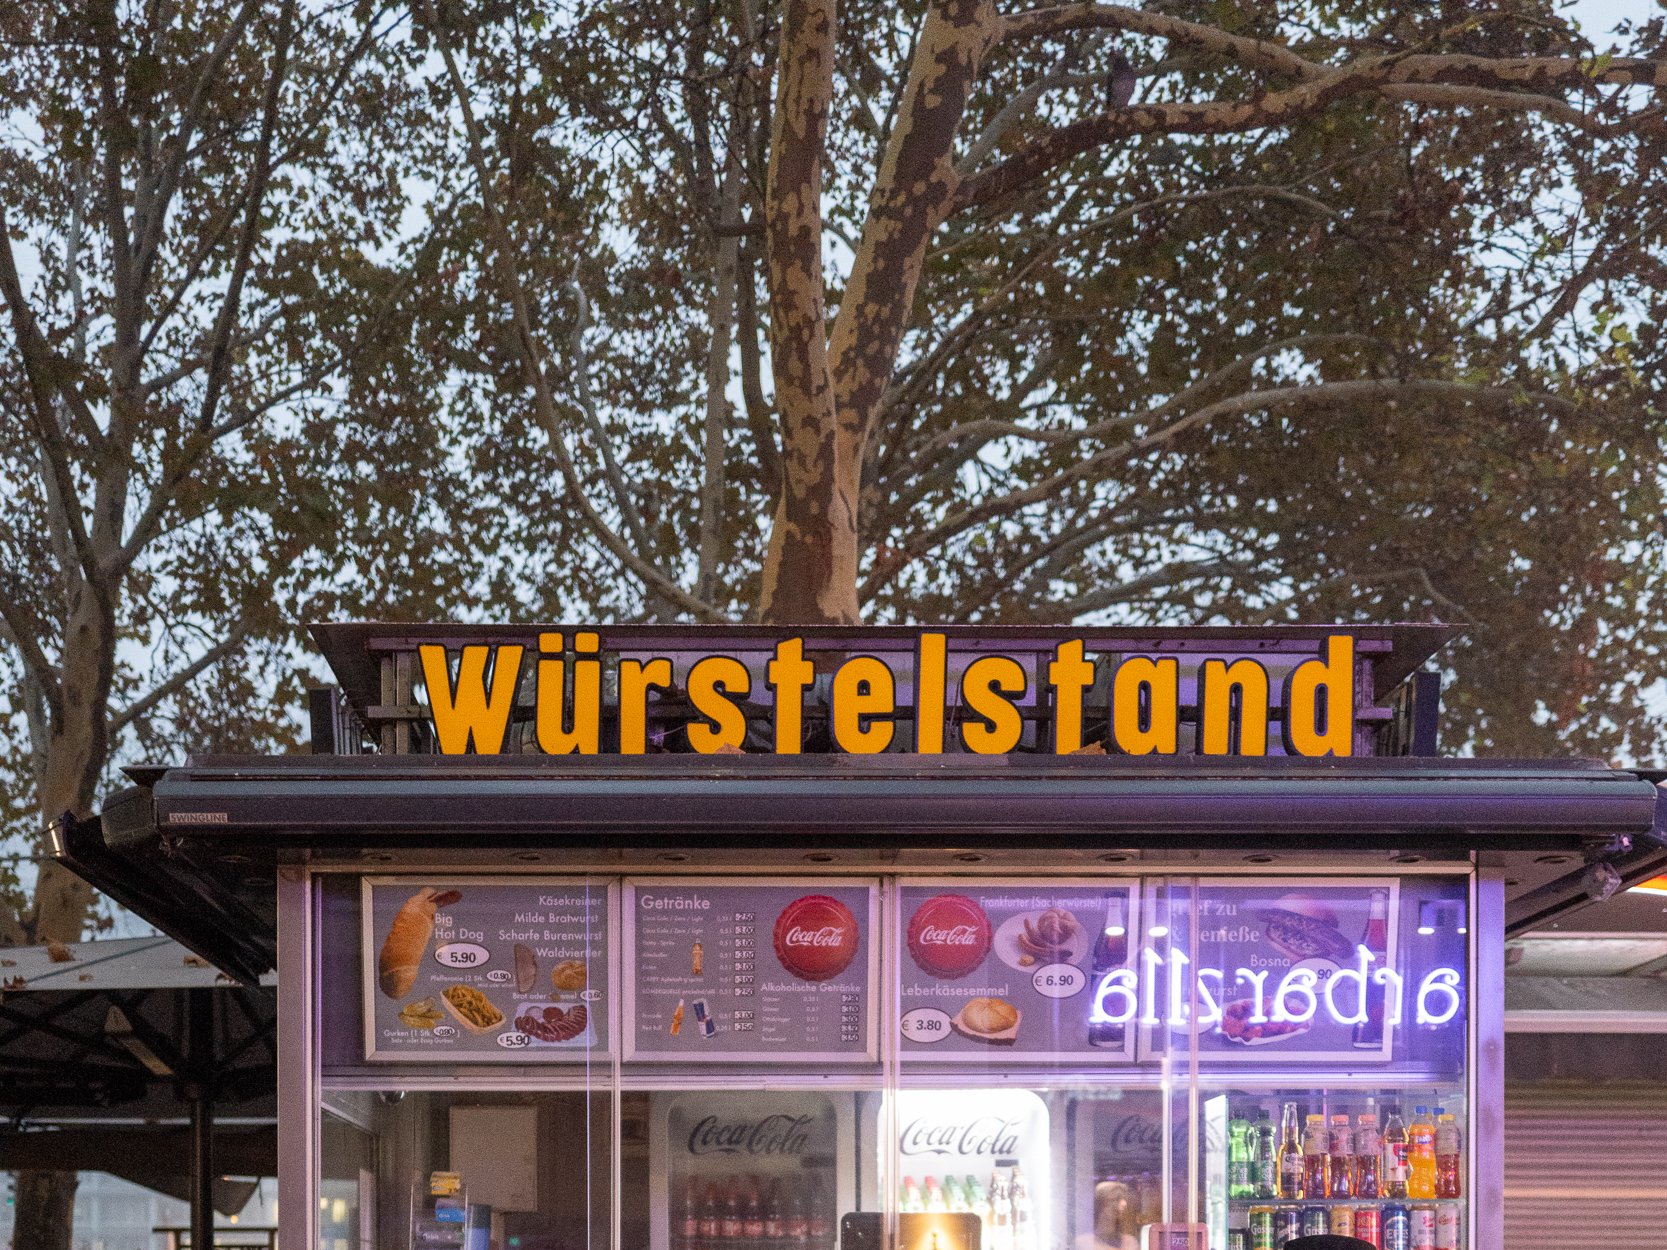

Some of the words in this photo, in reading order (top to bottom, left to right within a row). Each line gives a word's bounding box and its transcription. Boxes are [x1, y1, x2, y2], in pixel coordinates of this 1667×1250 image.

[418, 631, 1354, 756] Würstelstand
[641, 894, 710, 909] Getränke
[1216, 903, 1238, 916] zu
[435, 912, 453, 927] Big
[514, 912, 545, 923] Milde
[435, 928, 455, 939] Hot
[460, 928, 484, 942] Dog
[499, 929, 540, 940] Scharfe
[785, 926, 847, 947] Coca-Cola
[919, 925, 980, 945] Coca-Cola
[450, 952, 476, 963] 5.90
[1250, 954, 1291, 967] Bosna
[1046, 974, 1074, 986] 6.90
[760, 982, 817, 992] Alkoholische
[820, 982, 861, 992] Getränke
[901, 983, 1009, 996] Leberkäsesemmel
[902, 1020, 909, 1031] €
[916, 1020, 942, 1031] 3.80
[505, 1035, 530, 1046] 5.90
[687, 1113, 815, 1156] Coca-Cola
[899, 1116, 1024, 1156] Coca-Cola
